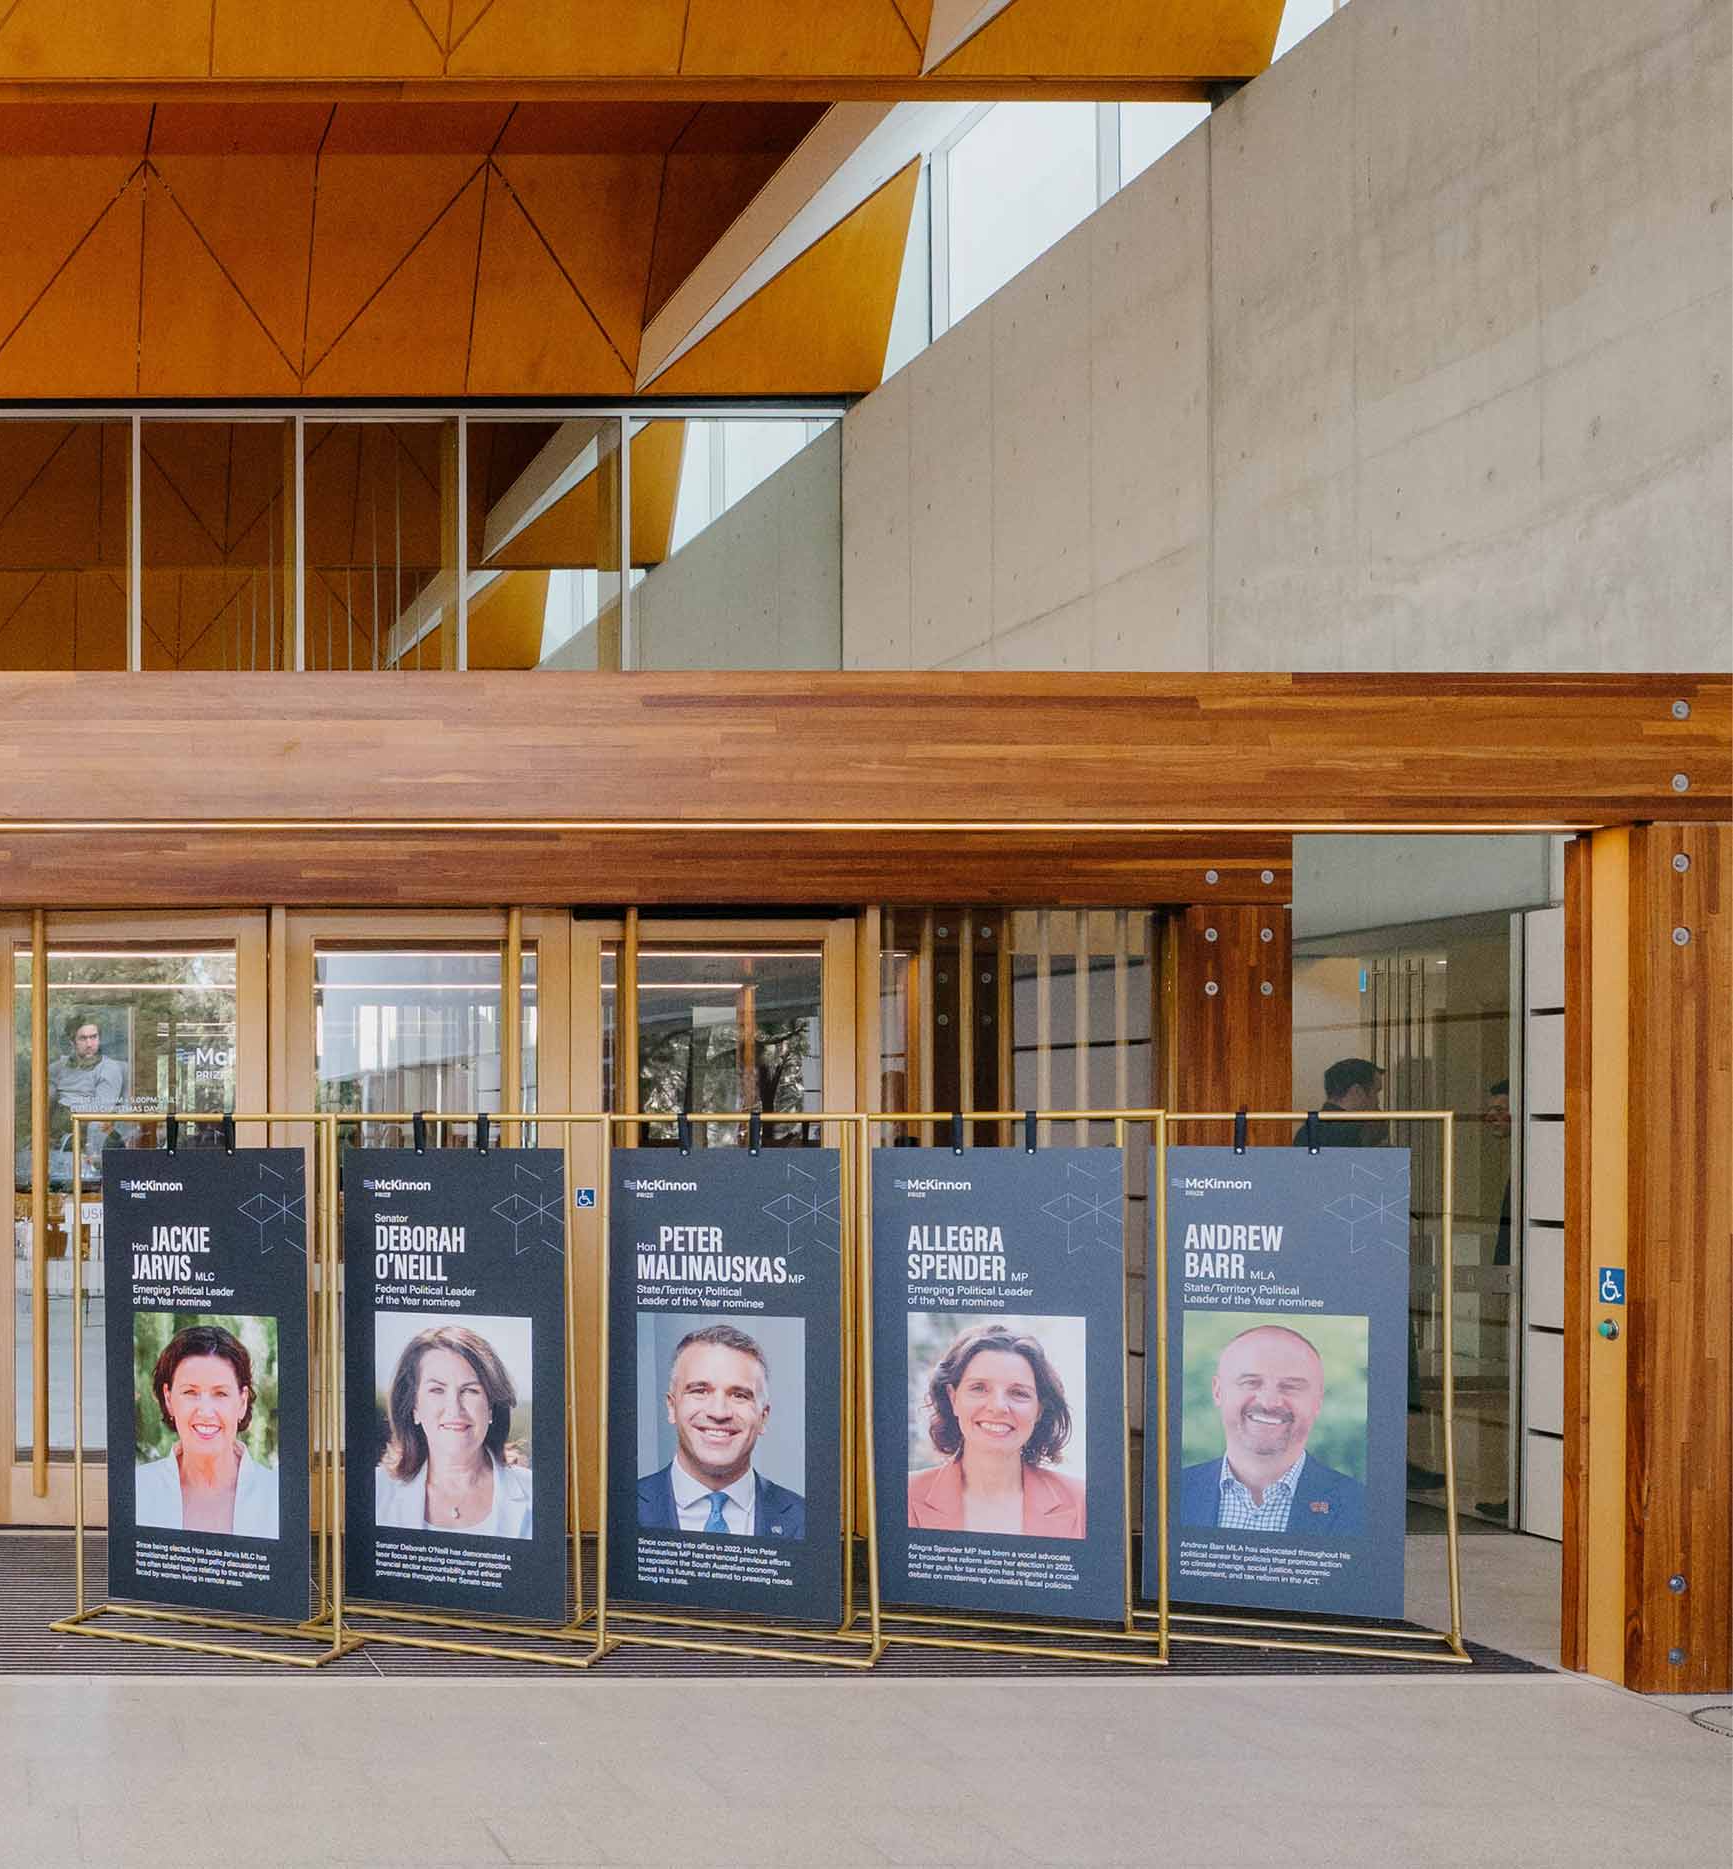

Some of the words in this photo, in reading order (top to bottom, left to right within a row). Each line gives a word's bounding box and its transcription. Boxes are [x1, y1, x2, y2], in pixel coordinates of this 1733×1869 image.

[131, 1181, 182, 1191] McKinnon
[375, 1180, 431, 1191] McKinnon
[636, 1180, 697, 1191] McKinnon
[908, 1180, 971, 1190] McKinnon
[1185, 1178, 1251, 1190] McKinnon
[375, 1214, 408, 1223] Senator
[132, 1242, 148, 1251] Hon
[151, 1226, 210, 1253] JACKIE
[375, 1225, 465, 1253] DEBORAH
[637, 1242, 656, 1251] Hon
[660, 1226, 722, 1253] PETER
[908, 1225, 1004, 1252] ALLEGRA
[1184, 1224, 1283, 1251] ANDREW
[132, 1254, 191, 1281] JARVIS
[195, 1272, 215, 1281] MLC
[637, 1254, 786, 1284] MALINAUSKAS
[789, 1274, 805, 1283] MP
[908, 1254, 1005, 1281] SPENDER
[1011, 1273, 1028, 1281] MP
[1185, 1253, 1244, 1279] BARR
[1250, 1271, 1276, 1280] MLA
[133, 1285, 170, 1296] Emerging
[173, 1286, 203, 1295] Political
[206, 1287, 234, 1296] Leader
[376, 1284, 407, 1294] Federal
[410, 1285, 442, 1295] Political
[445, 1287, 476, 1296] Leader
[637, 1285, 702, 1296] State/Territory
[706, 1287, 741, 1296] Political
[908, 1284, 954, 1296] Emerging
[957, 1286, 995, 1295] Political
[998, 1287, 1033, 1296] Leader
[1184, 1283, 1256, 1295] State/Territory
[1259, 1285, 1299, 1295] Political
[133, 1295, 142, 1304] of
[143, 1296, 157, 1305] the
[158, 1296, 174, 1306] Year
[176, 1297, 211, 1307] nominee
[375, 1295, 384, 1304] of
[386, 1296, 400, 1305] the
[401, 1296, 420, 1305] Year
[423, 1297, 460, 1307] nominee
[637, 1296, 668, 1305] Leader
[671, 1297, 682, 1306] of
[683, 1297, 698, 1307] the
[700, 1298, 720, 1307] Year
[723, 1298, 764, 1308] nominee
[908, 1295, 918, 1304] of
[920, 1296, 935, 1305] the
[938, 1296, 959, 1306] Year
[962, 1297, 1004, 1307] nominee
[1184, 1295, 1219, 1304] Leader
[1222, 1295, 1233, 1305] of
[1234, 1296, 1251, 1305] the
[1254, 1297, 1275, 1306] Year
[1278, 1298, 1324, 1308] nominee
